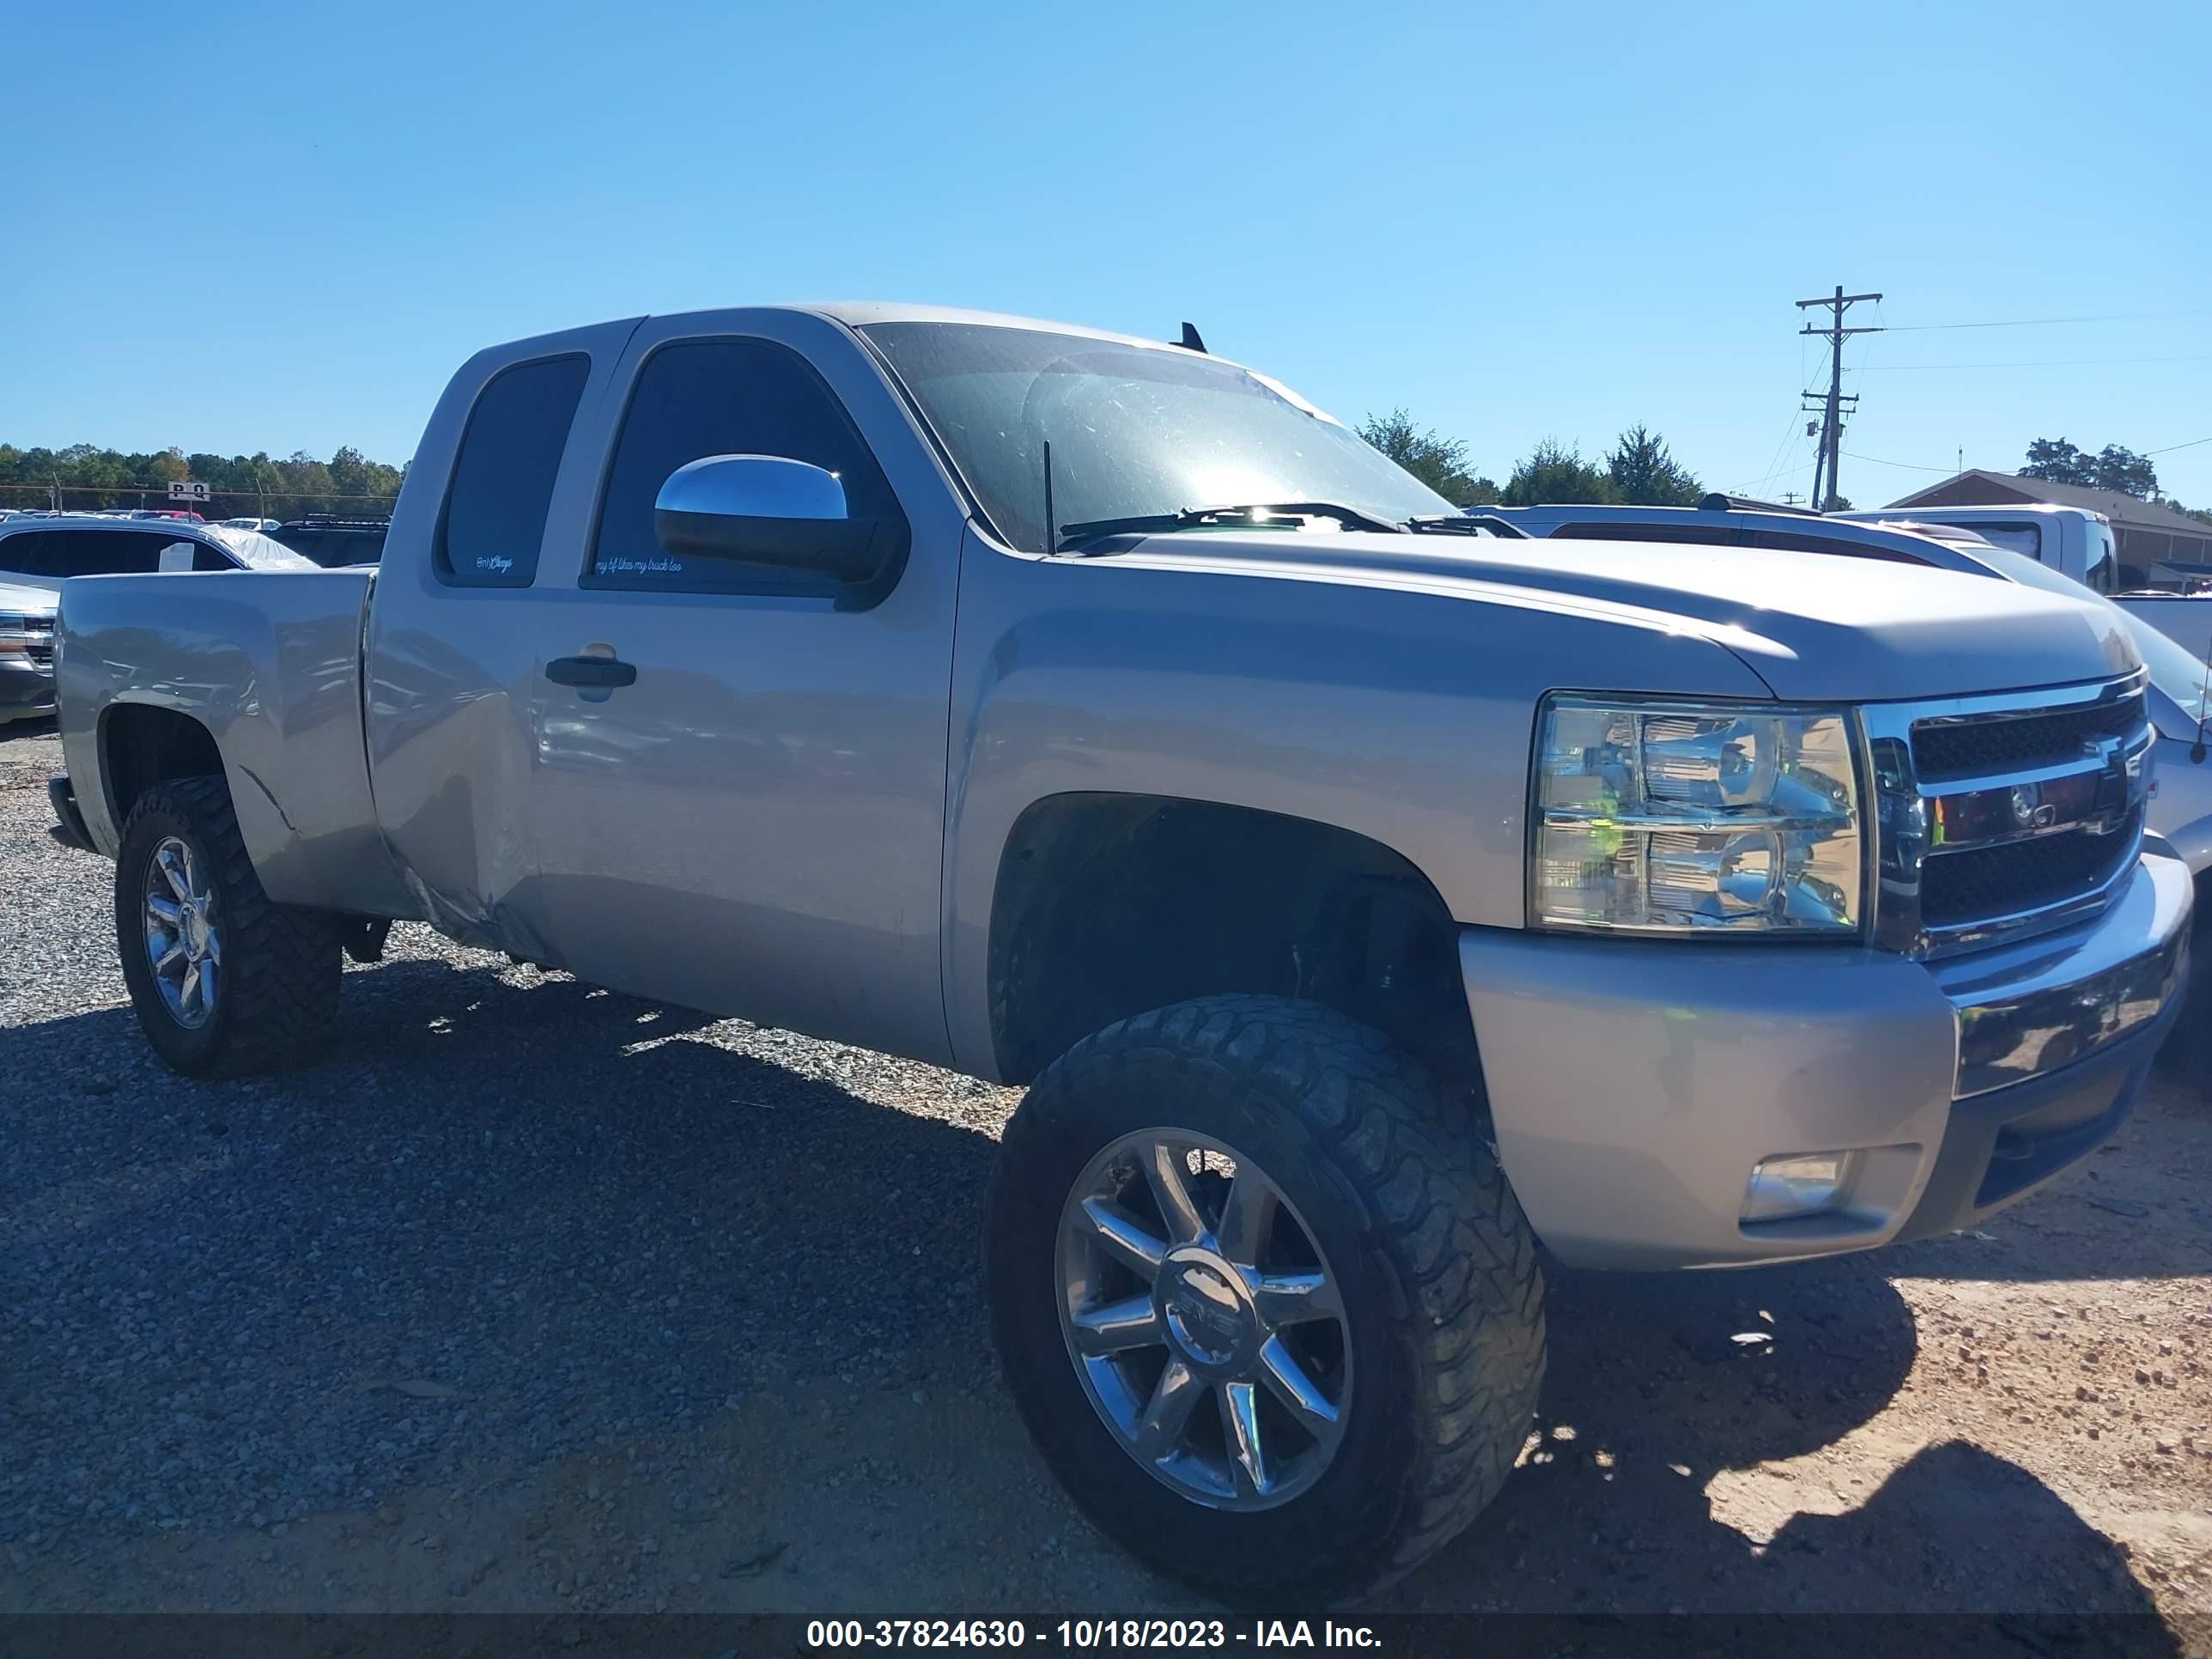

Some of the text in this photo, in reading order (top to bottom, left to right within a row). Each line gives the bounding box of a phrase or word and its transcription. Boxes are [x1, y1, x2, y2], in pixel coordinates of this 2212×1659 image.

[173, 484, 204, 499] P Q
[596, 557, 682, 574] my bf likes my truck too
